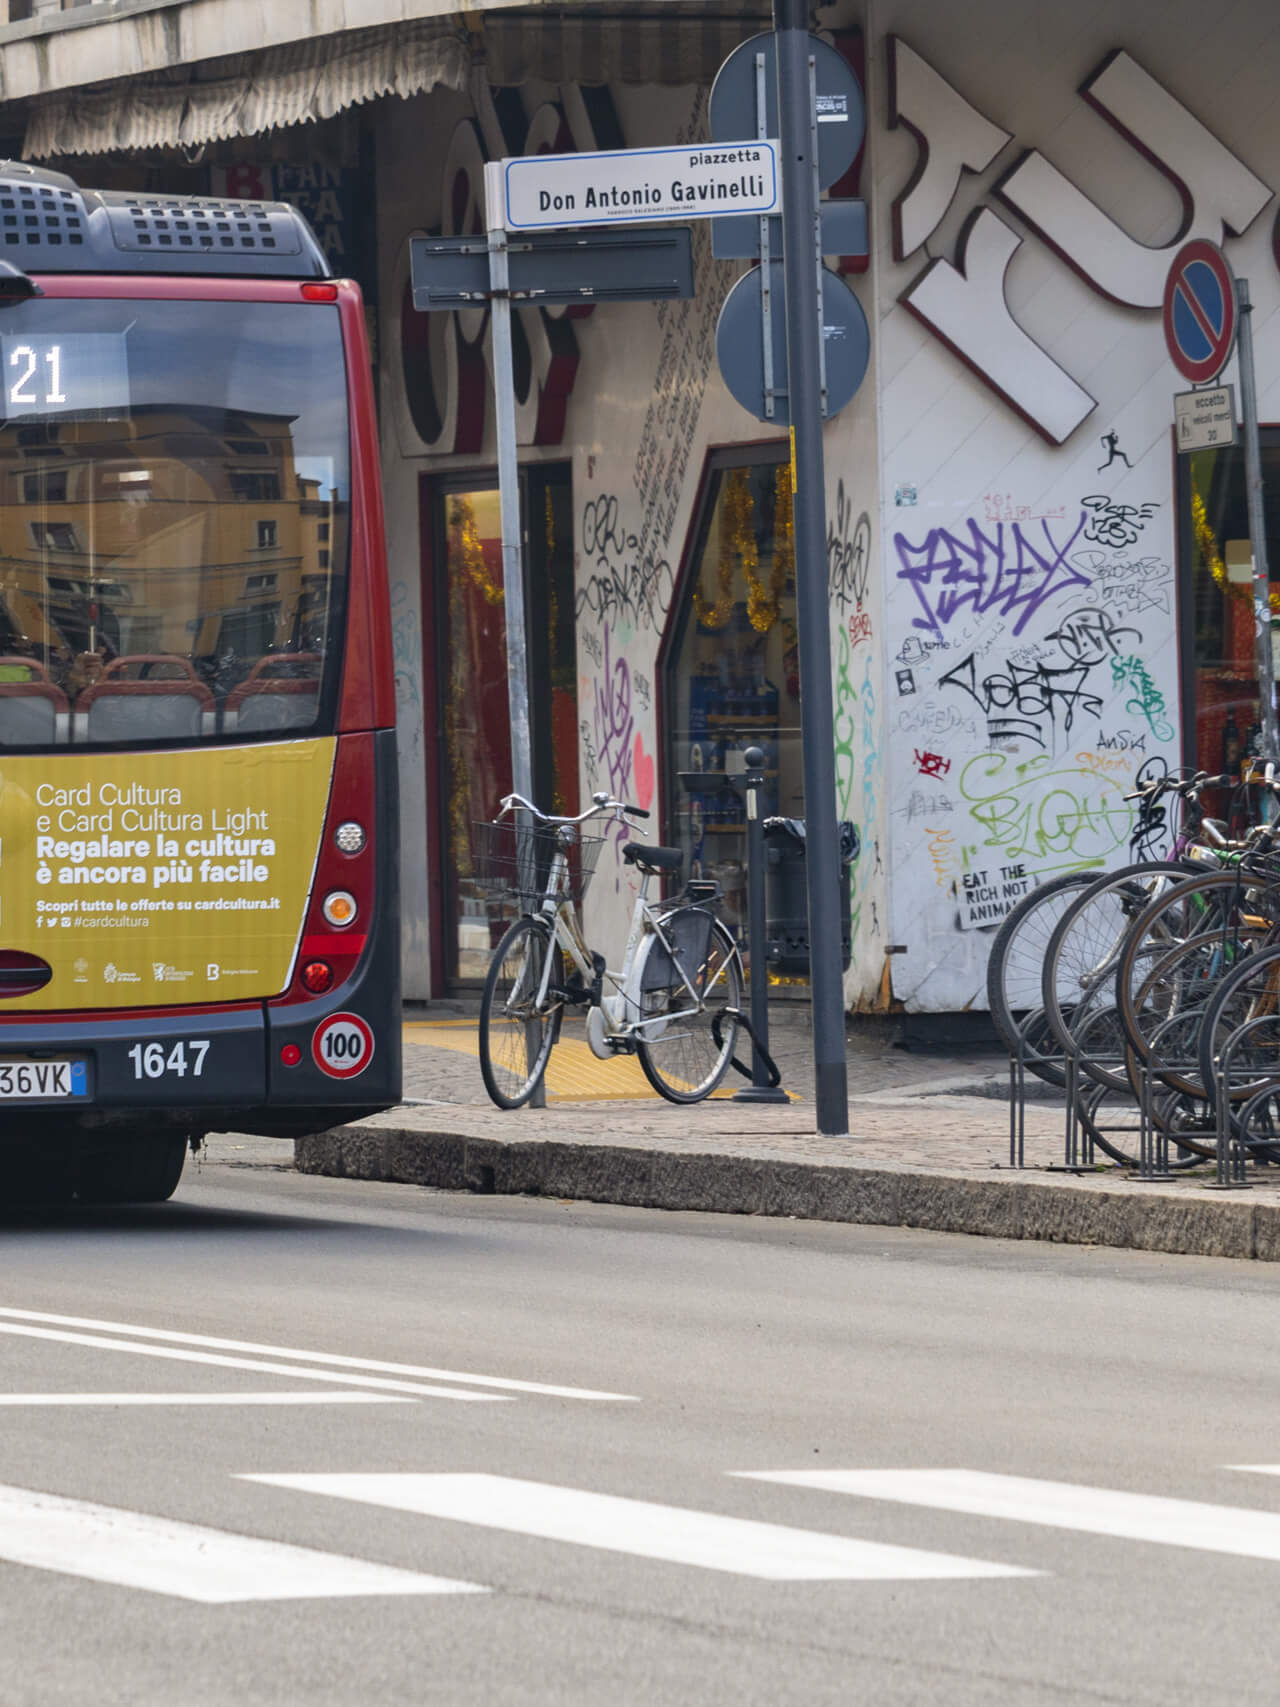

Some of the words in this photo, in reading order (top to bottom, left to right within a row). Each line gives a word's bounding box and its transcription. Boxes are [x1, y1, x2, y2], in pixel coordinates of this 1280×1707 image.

[689, 149, 760, 168] piazzetta
[539, 190, 575, 212] Don
[585, 183, 662, 208] Antonio
[671, 175, 764, 202] Gavinelli
[10, 345, 65, 403] 21
[36, 782, 91, 806] Card
[99, 782, 182, 806] Cultura
[36, 815, 51, 832] e
[58, 809, 113, 832] Card
[121, 808, 203, 832] Cultura
[212, 806, 269, 836] Light
[37, 834, 150, 863] Regalare
[156, 834, 179, 857] la
[185, 833, 276, 857] cultura
[36, 861, 52, 884] è
[58, 867, 147, 884] ancora
[153, 860, 193, 888] più
[199, 859, 269, 883] facile
[963, 871, 988, 889] EAT
[1000, 864, 1026, 880] THE
[966, 886, 998, 904] RICH
[1003, 881, 1028, 898] NOT
[36, 899, 78, 914] Scopri
[81, 899, 113, 912] tutte
[116, 899, 128, 911] le
[130, 898, 174, 911] offerte
[177, 900, 193, 910] su
[195, 897, 280, 910] cardcultura.it
[74, 916, 149, 928] #cardcultura
[326, 1033, 361, 1058] 100
[128, 1040, 211, 1079] 1647
